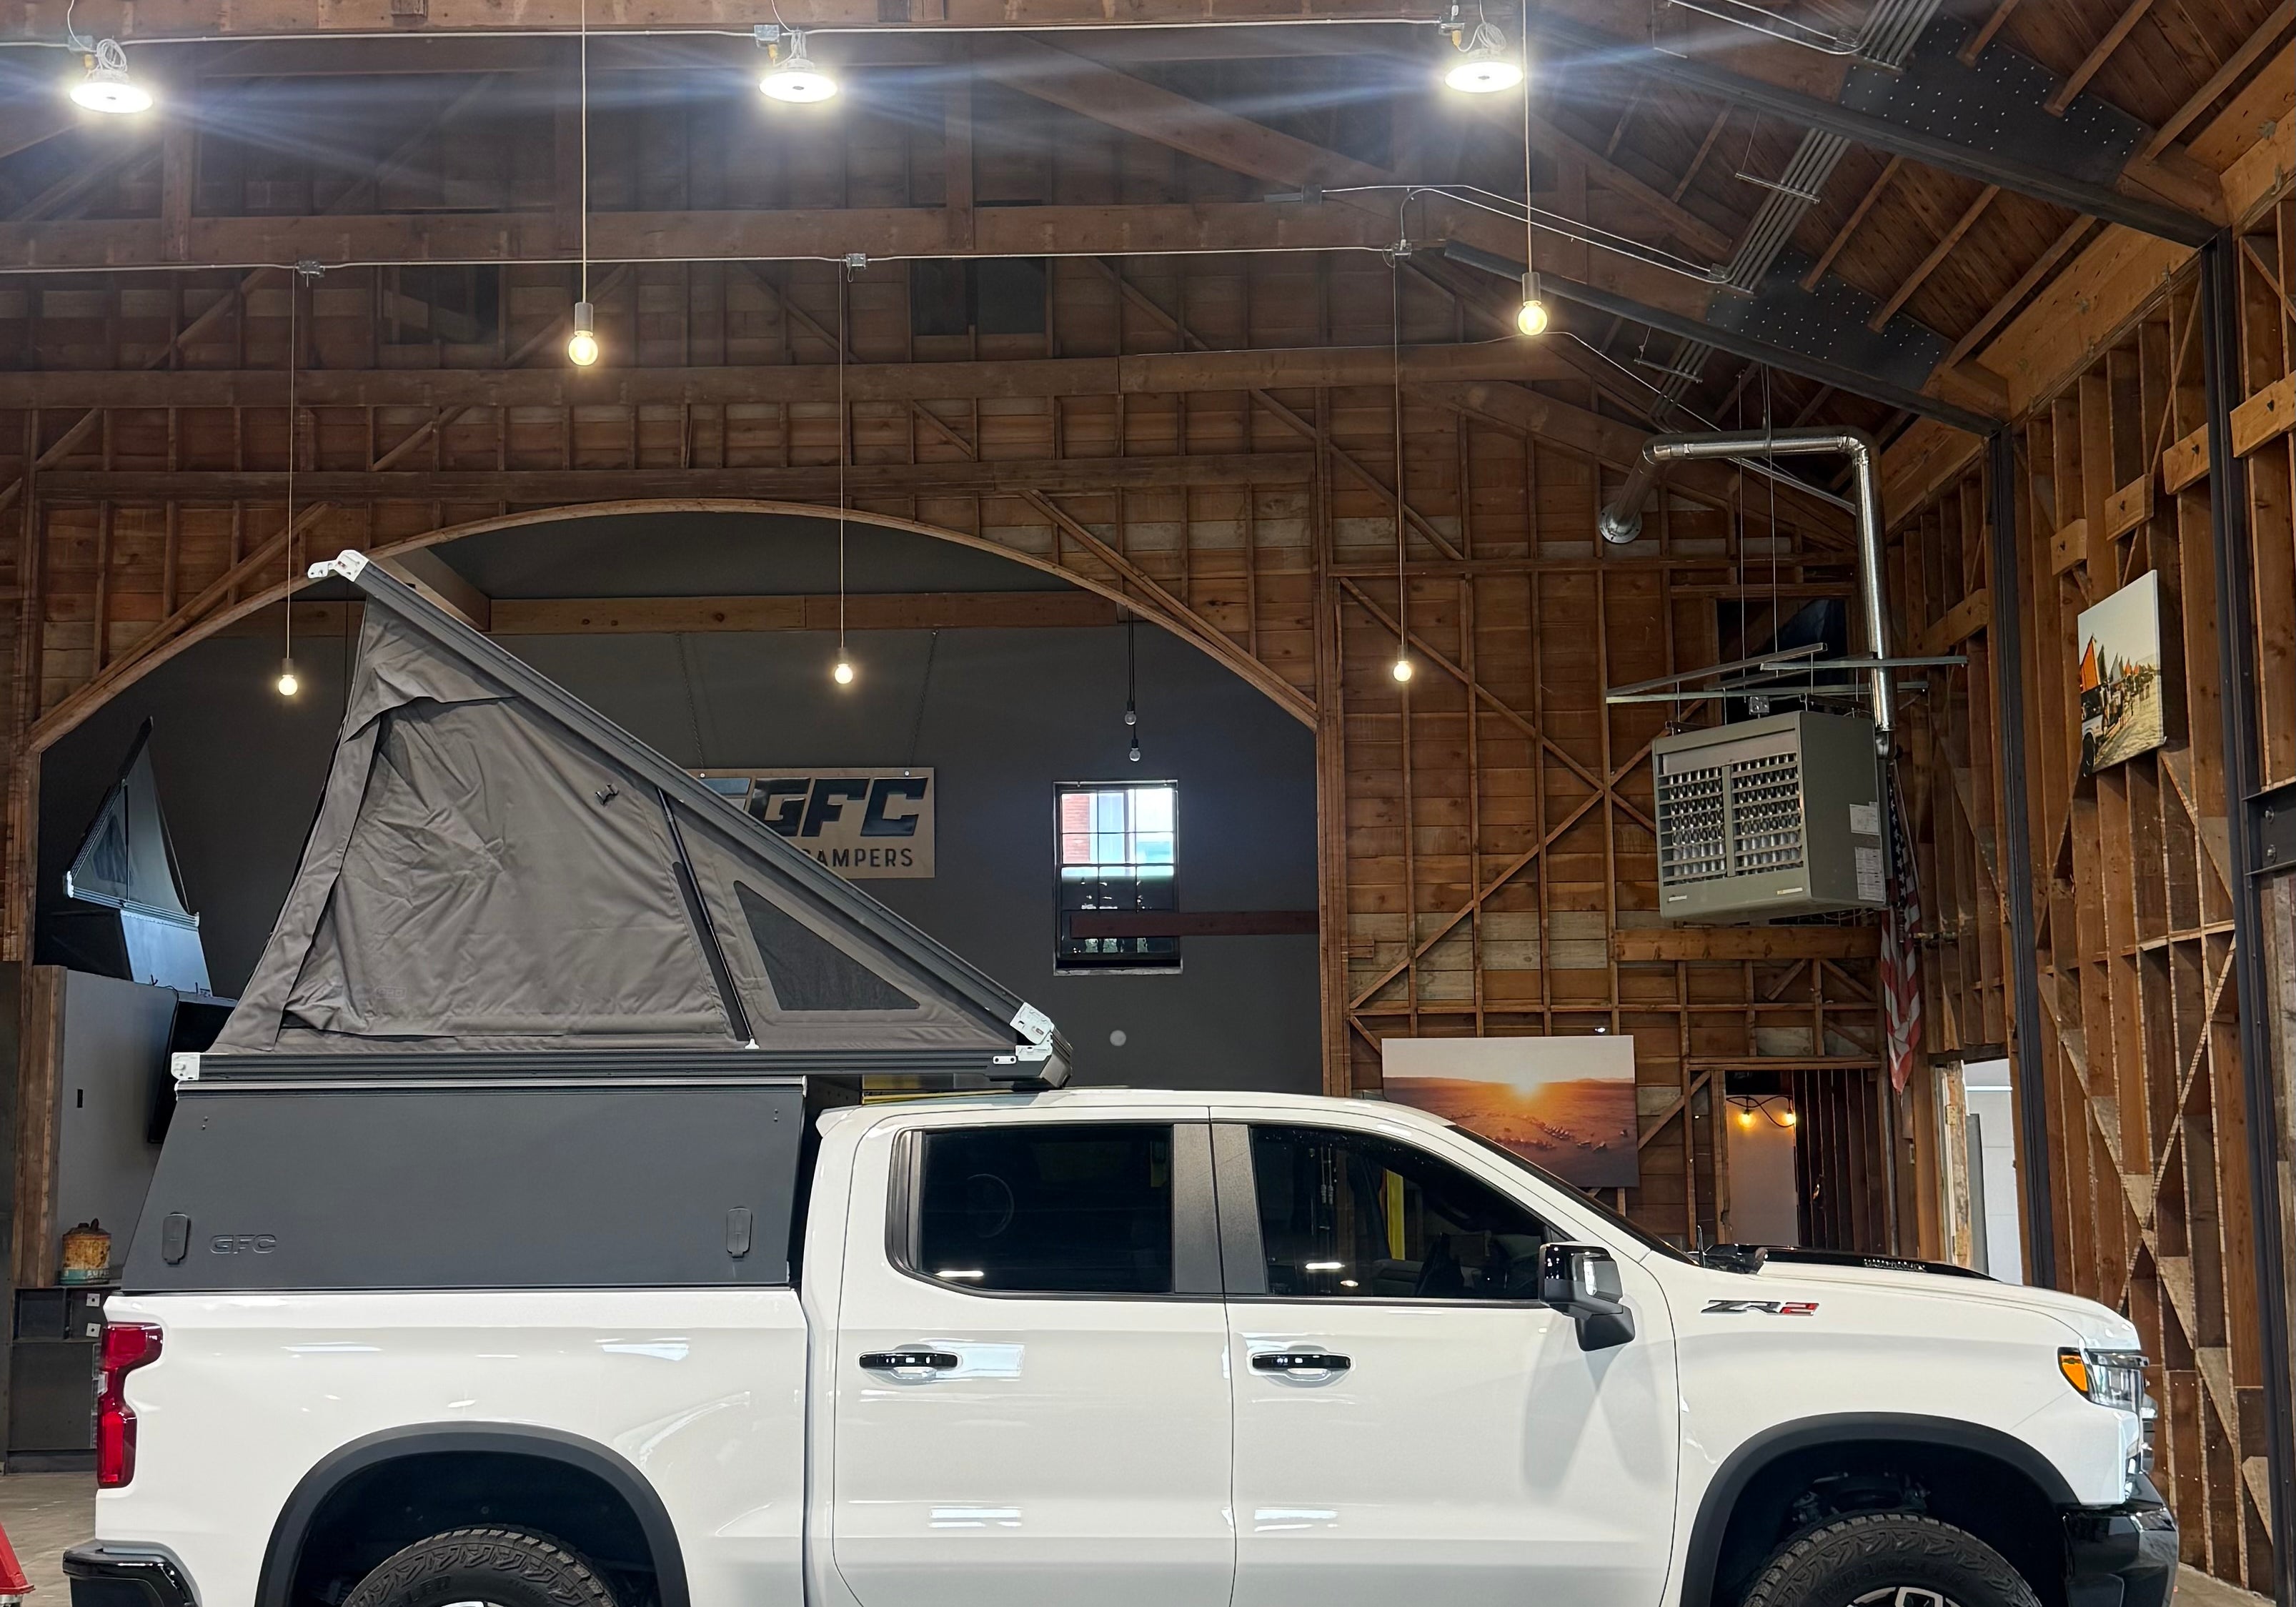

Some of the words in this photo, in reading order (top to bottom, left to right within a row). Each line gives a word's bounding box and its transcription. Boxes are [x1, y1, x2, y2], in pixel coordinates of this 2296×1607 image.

[748, 777, 928, 837] GFC
[210, 1234, 277, 1254] GFC
[1701, 1300, 1819, 1316] ZR2
